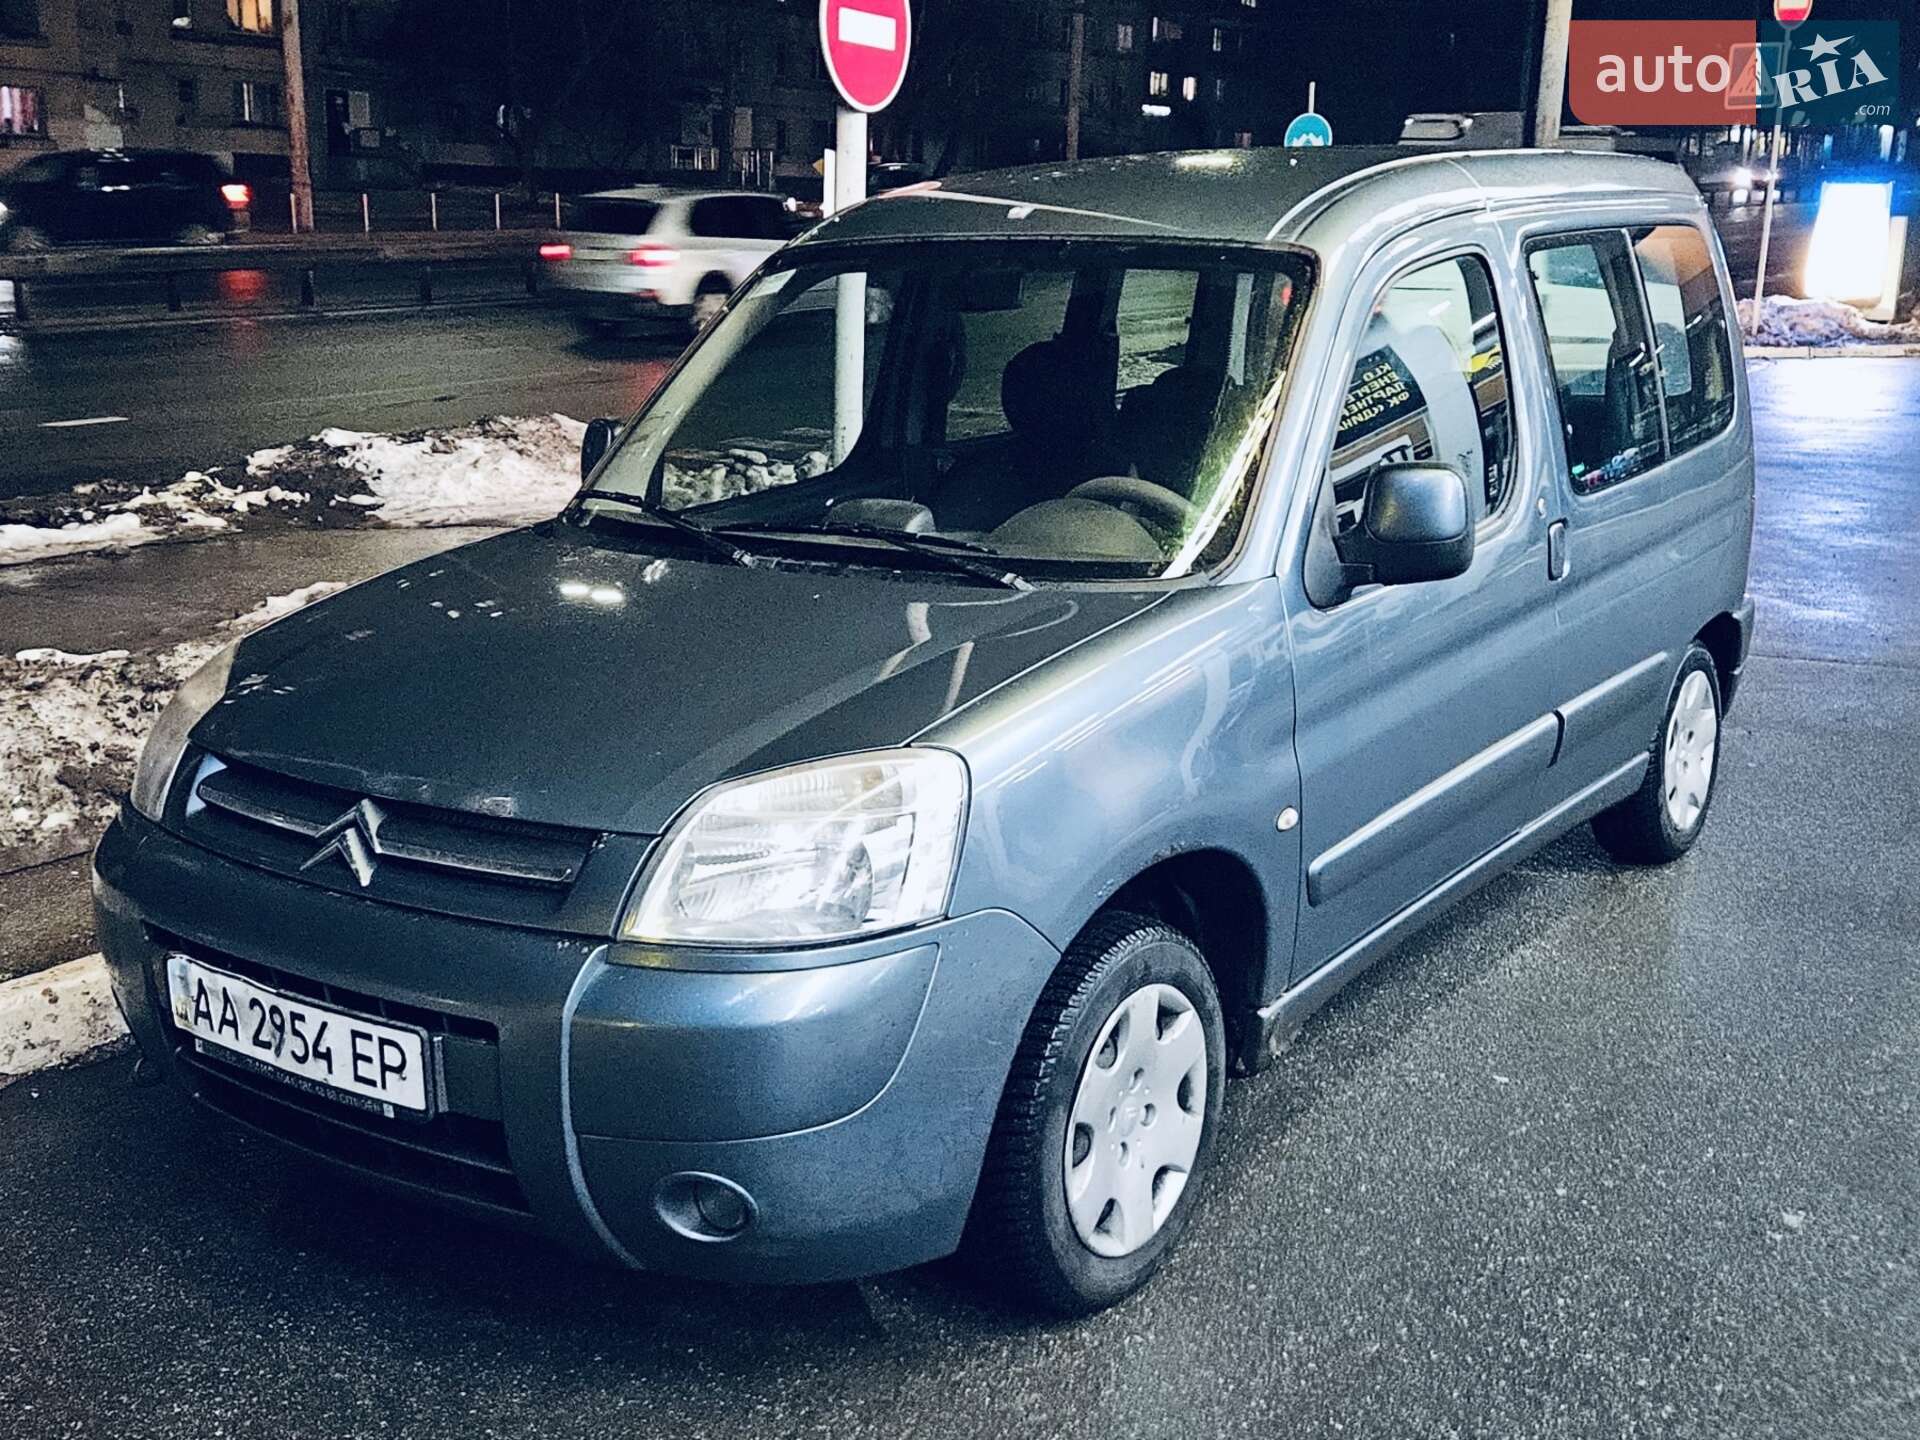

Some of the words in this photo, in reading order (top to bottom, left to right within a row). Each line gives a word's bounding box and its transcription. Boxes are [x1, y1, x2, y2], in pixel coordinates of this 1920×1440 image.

[193, 977, 240, 1042] AA
[249, 997, 333, 1075] 2954
[350, 1028, 407, 1090] EP
